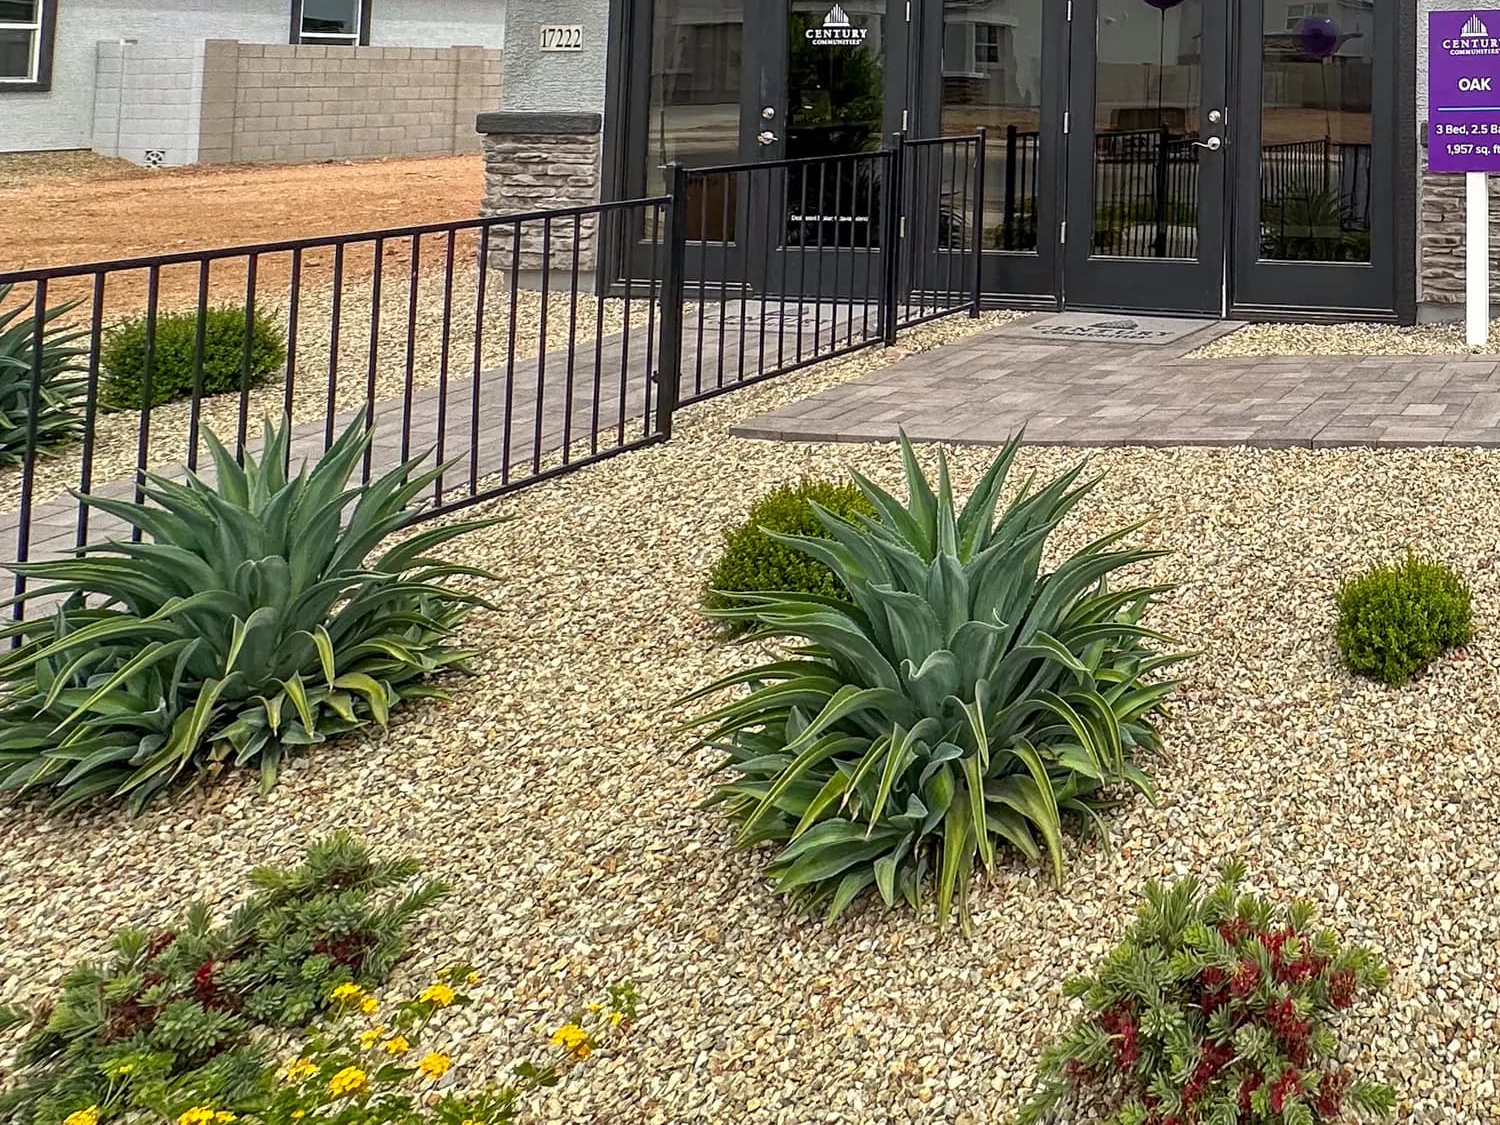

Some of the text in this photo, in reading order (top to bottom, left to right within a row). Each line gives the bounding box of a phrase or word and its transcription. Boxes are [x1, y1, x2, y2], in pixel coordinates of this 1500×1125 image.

[541, 29, 580, 47] 17222
[805, 29, 867, 39] CENTURY
[1458, 78, 1491, 91] OAK
[1436, 124, 1443, 134] 3
[1445, 124, 1469, 135] Bed,
[1471, 124, 1488, 134] 2.5
[1446, 144, 1474, 155] 1,957
[1475, 147, 1491, 155] sq.
